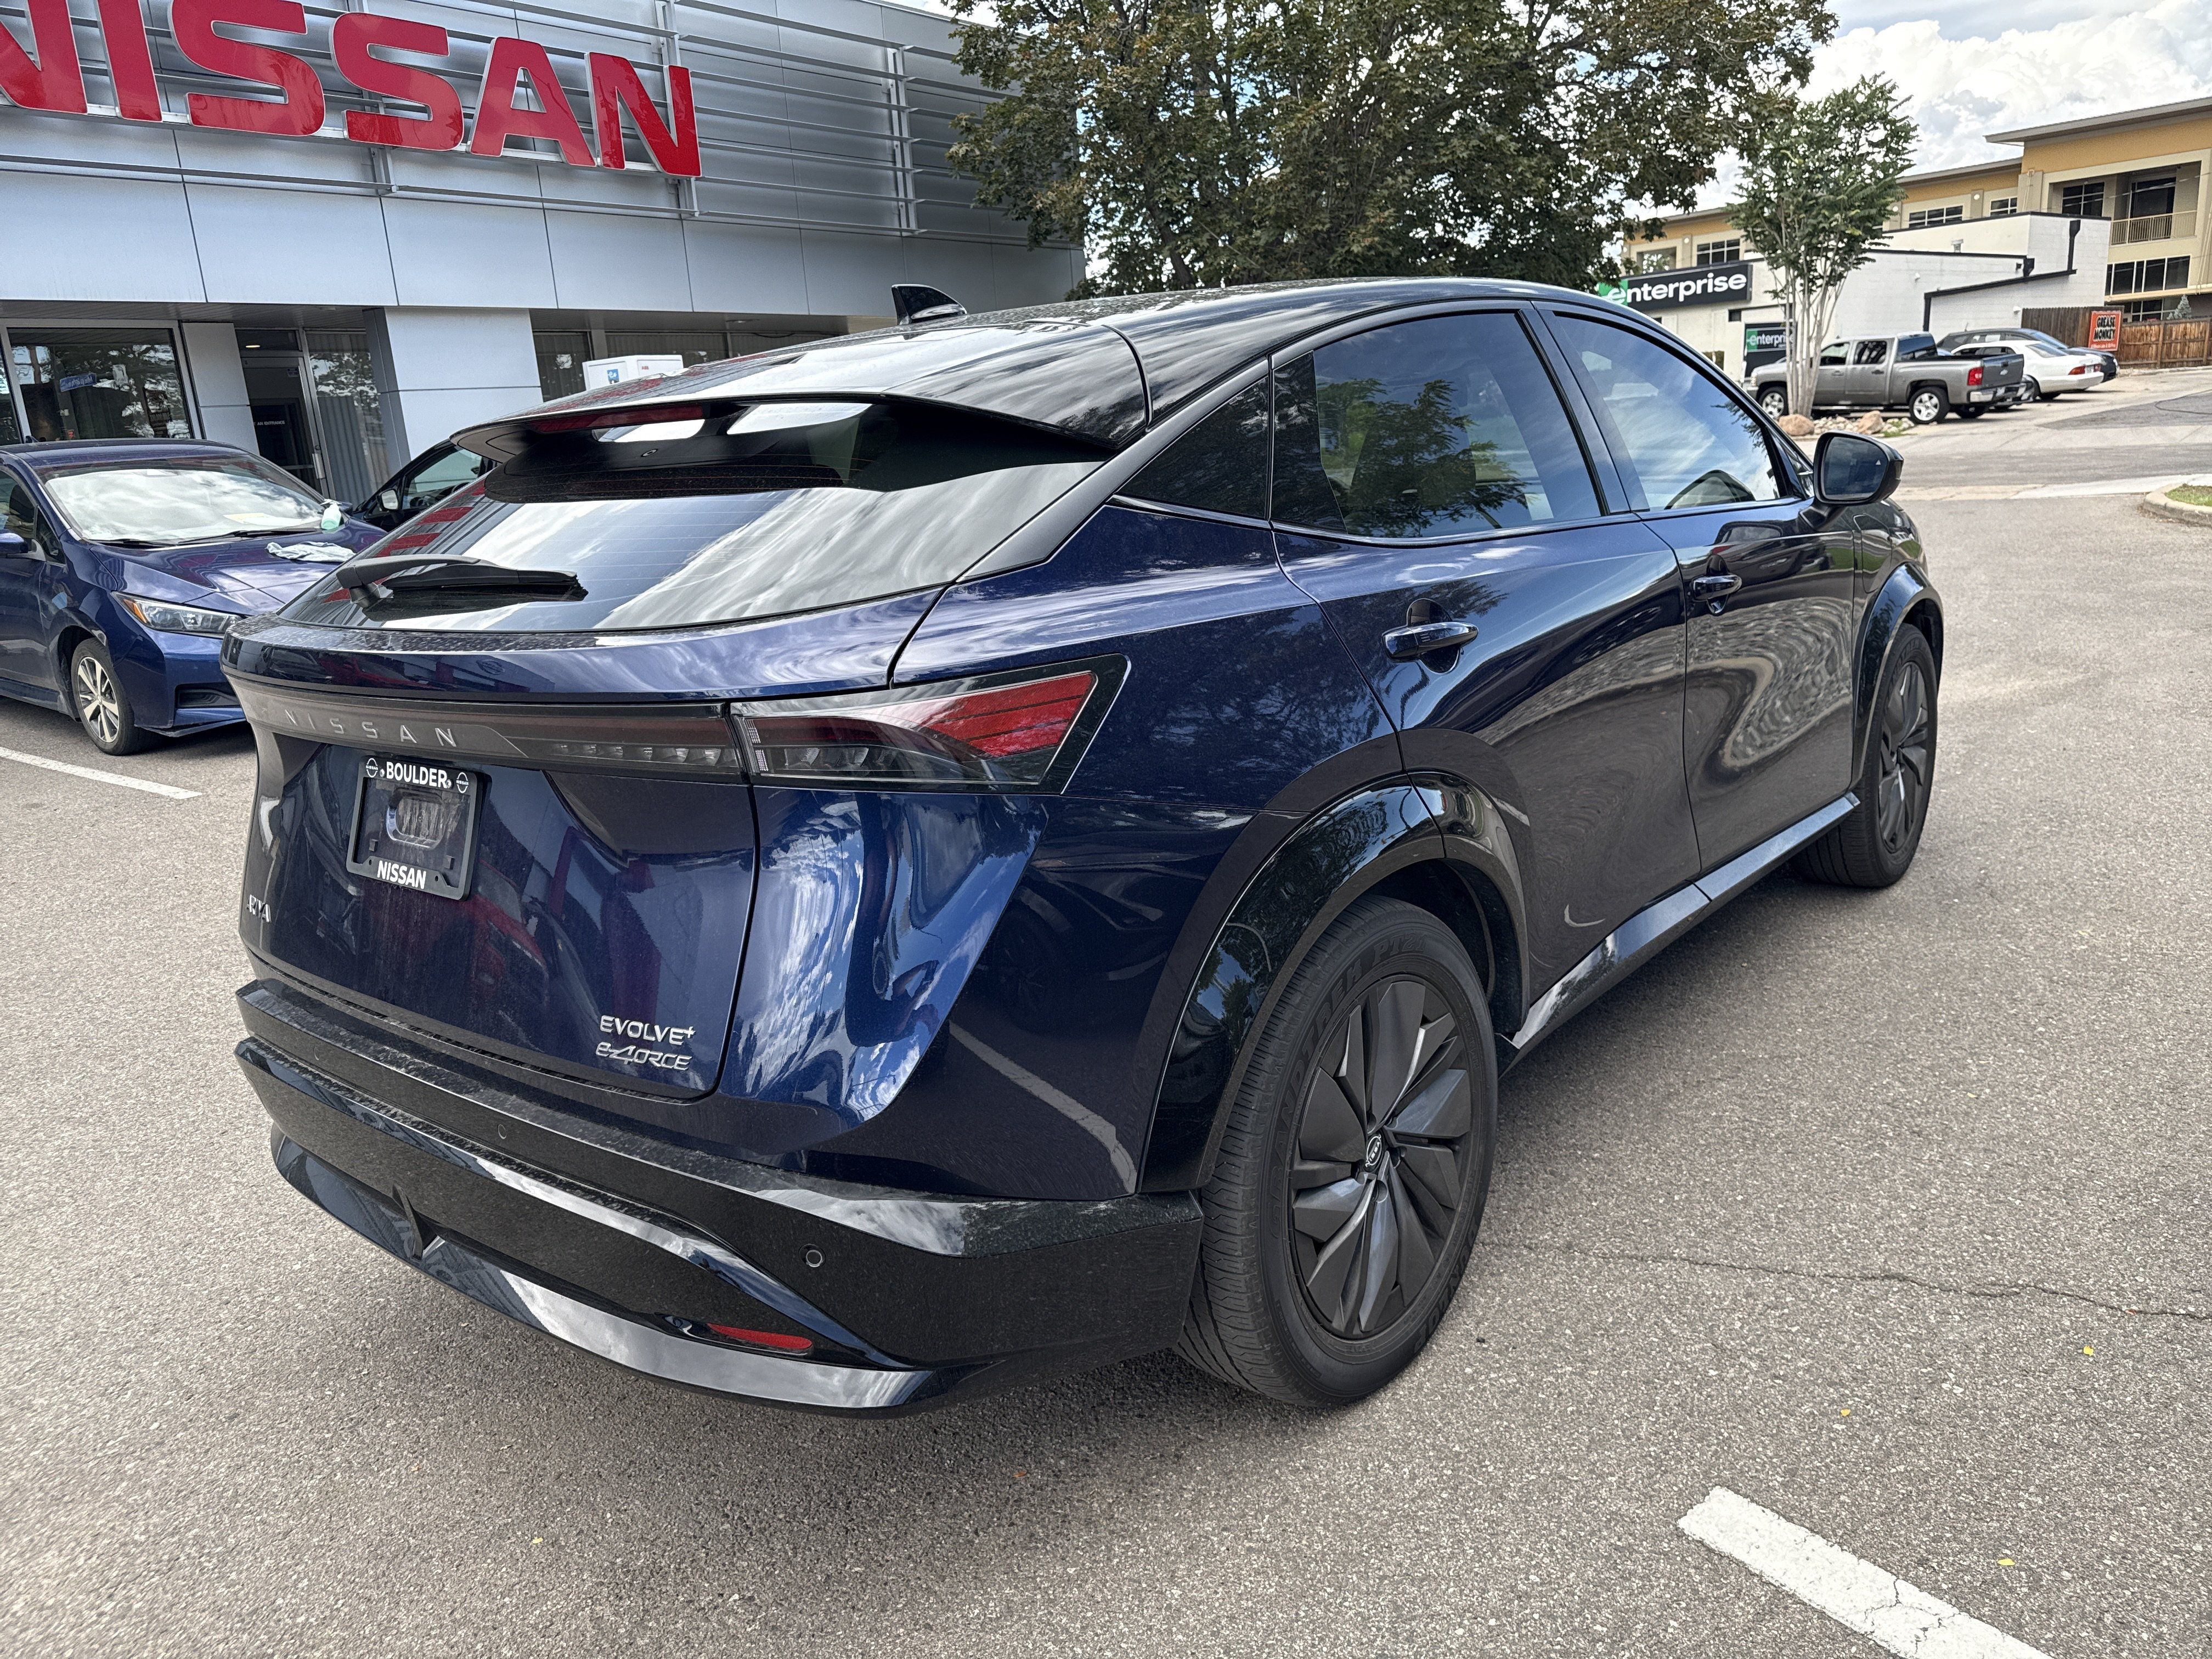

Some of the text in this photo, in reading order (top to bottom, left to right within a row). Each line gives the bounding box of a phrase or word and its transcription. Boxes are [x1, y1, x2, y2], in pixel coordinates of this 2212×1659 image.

[1603, 272, 1747, 304] enterprise
[2093, 328, 2116, 340] MONKEY
[2097, 316, 2115, 328] GREASE
[1747, 331, 1795, 347] enterpri
[285, 709, 456, 747] NISSAN
[386, 761, 448, 789] BOULDER
[377, 860, 427, 889] NISSAN
